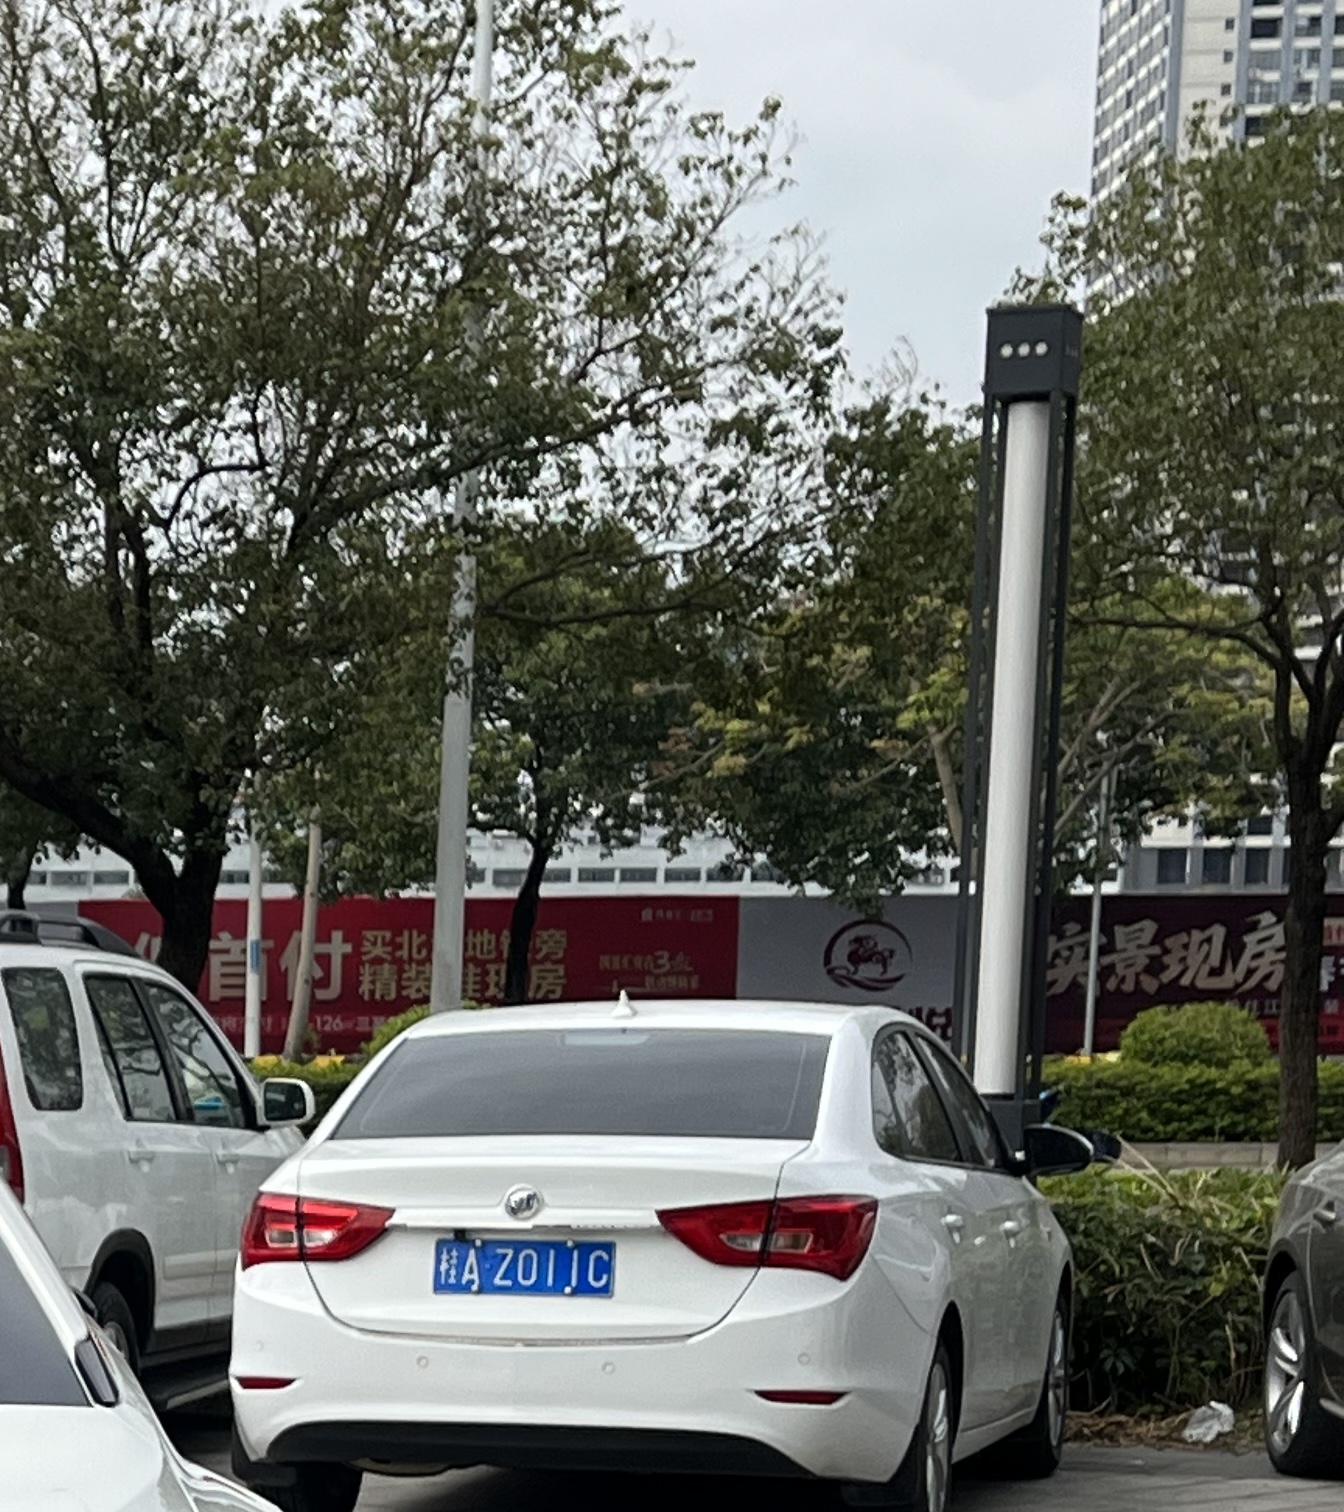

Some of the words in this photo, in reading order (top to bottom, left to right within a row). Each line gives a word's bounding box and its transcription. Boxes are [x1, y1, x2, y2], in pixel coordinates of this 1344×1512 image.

[360, 929, 568, 961] 买北地旁
[1046, 909, 1286, 997] 实景现房
